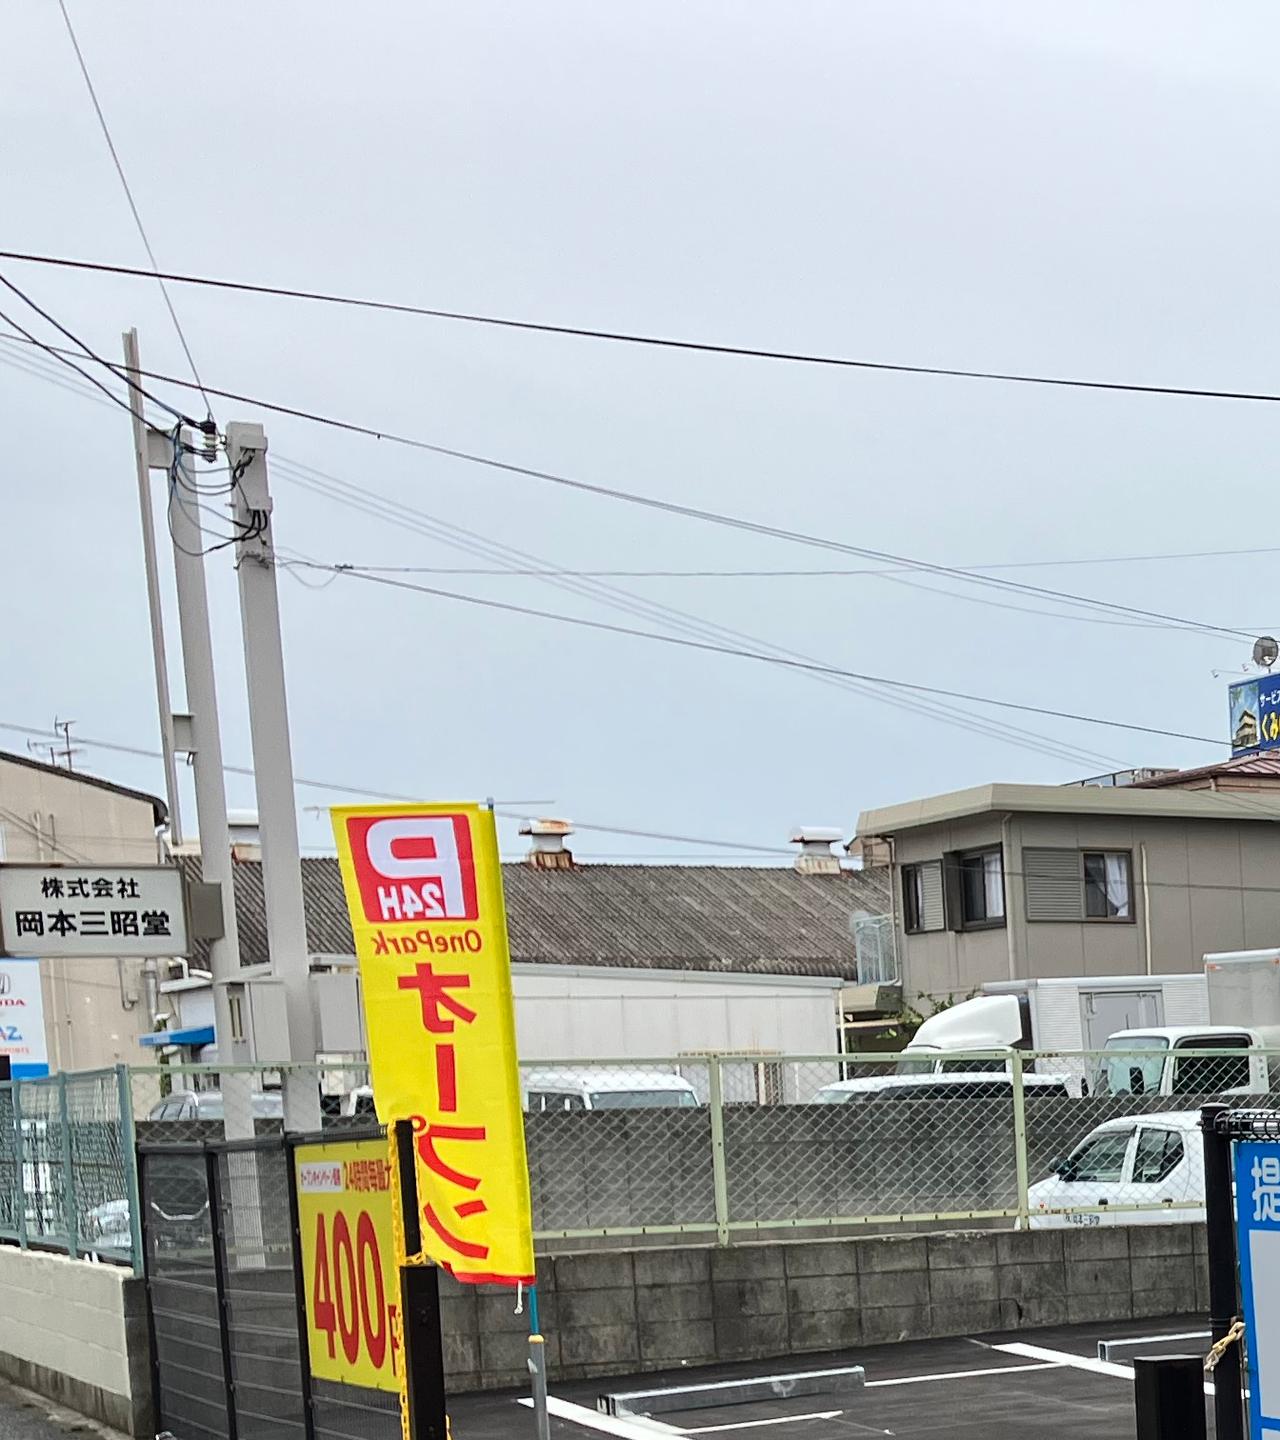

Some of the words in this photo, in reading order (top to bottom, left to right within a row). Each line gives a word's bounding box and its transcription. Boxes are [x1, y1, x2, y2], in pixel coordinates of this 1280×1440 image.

[41, 876, 141, 900] 株式会社
[15, 908, 172, 937] 岡本三昭堂
